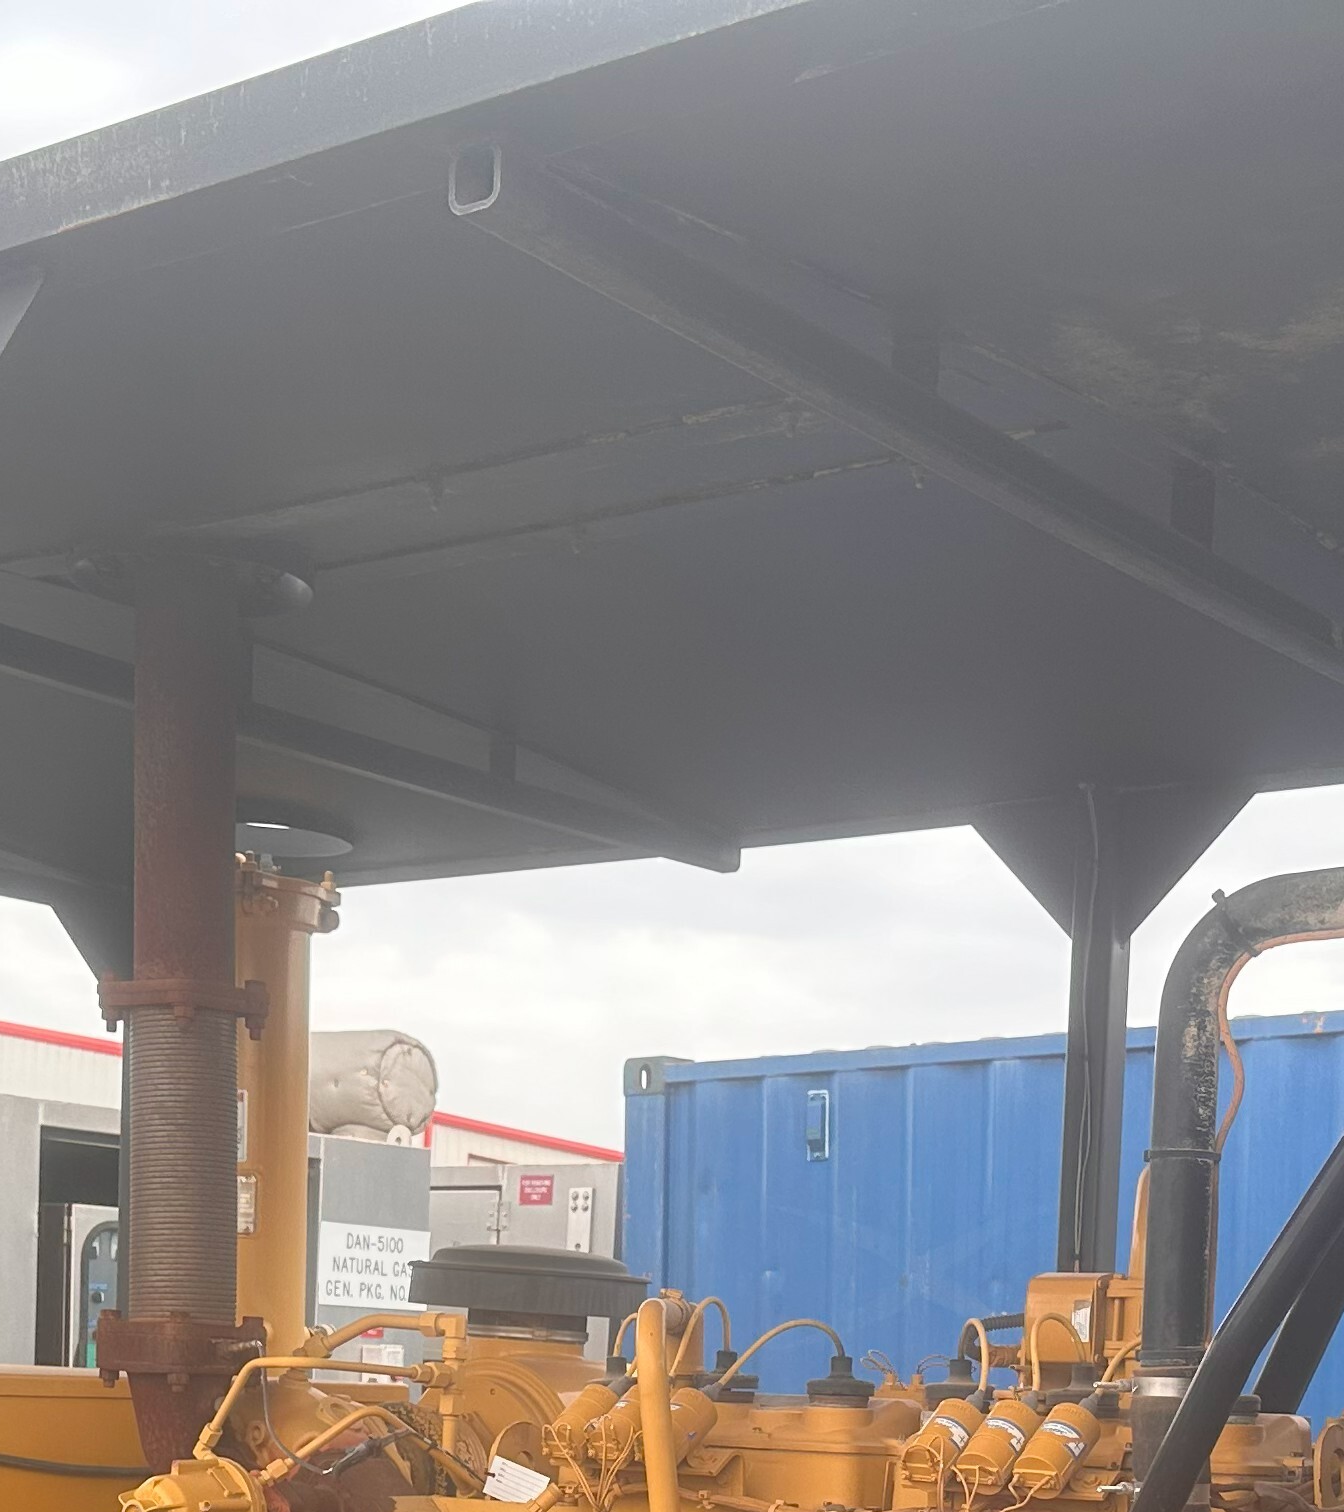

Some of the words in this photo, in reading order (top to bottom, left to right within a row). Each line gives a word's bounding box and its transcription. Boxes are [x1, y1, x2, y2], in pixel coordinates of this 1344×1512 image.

[346, 1232, 404, 1254] DAN-5100
[332, 1256, 388, 1277] NATURAL
[326, 1280, 353, 1298] GEN.
[359, 1282, 384, 1300] PKG.
